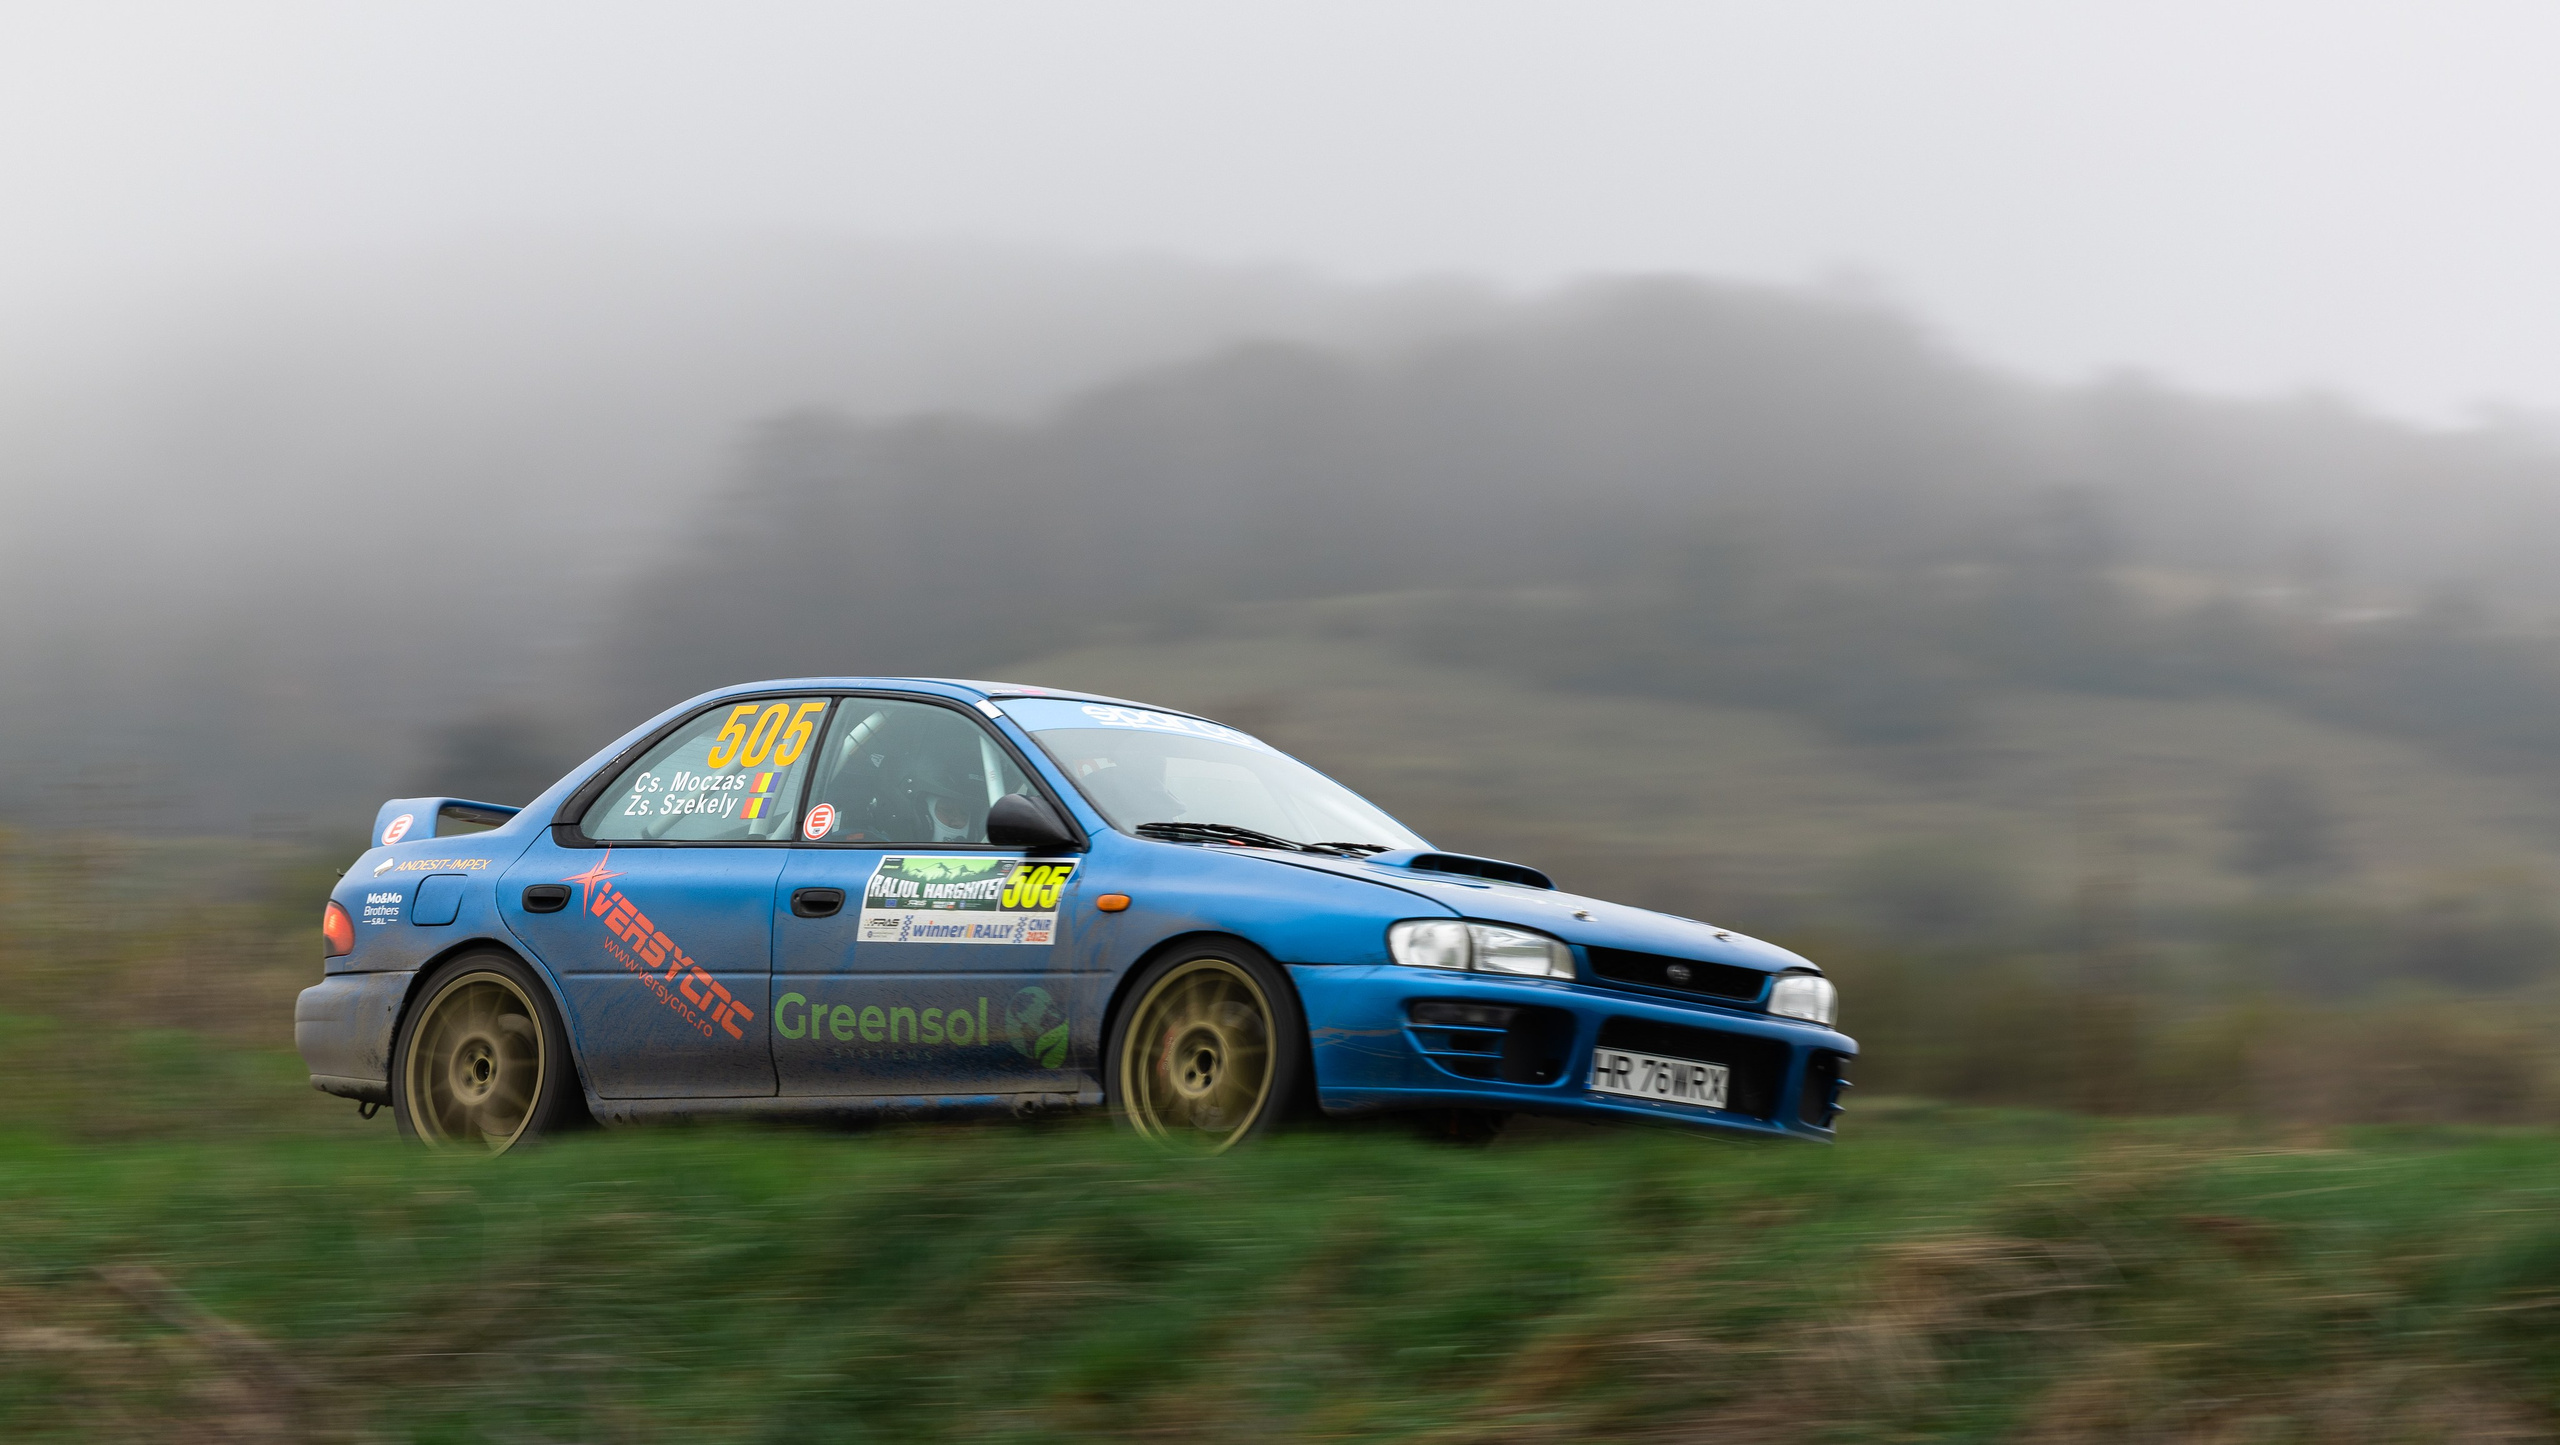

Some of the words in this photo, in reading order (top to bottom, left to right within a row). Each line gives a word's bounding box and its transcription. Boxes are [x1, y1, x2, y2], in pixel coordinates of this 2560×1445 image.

[707, 702, 826, 769] 505
[634, 772, 664, 793] Cs.
[670, 771, 747, 791] Moczas
[624, 795, 653, 816] Zs.
[660, 793, 738, 819] Szekely
[388, 820, 406, 838] E
[811, 811, 829, 827] E
[394, 859, 492, 872] ANDESIT-IMPEX
[869, 874, 920, 898] RALIUL
[1001, 865, 1073, 909] 505
[366, 893, 402, 904] Mo&Mo
[363, 905, 399, 916] Brothers
[913, 921, 966, 938] winner
[974, 925, 1014, 938] RALLY
[604, 935, 713, 1037] wwwversycnc.ro
[775, 992, 988, 1045] Greensol
[1593, 1053, 1634, 1091] HR
